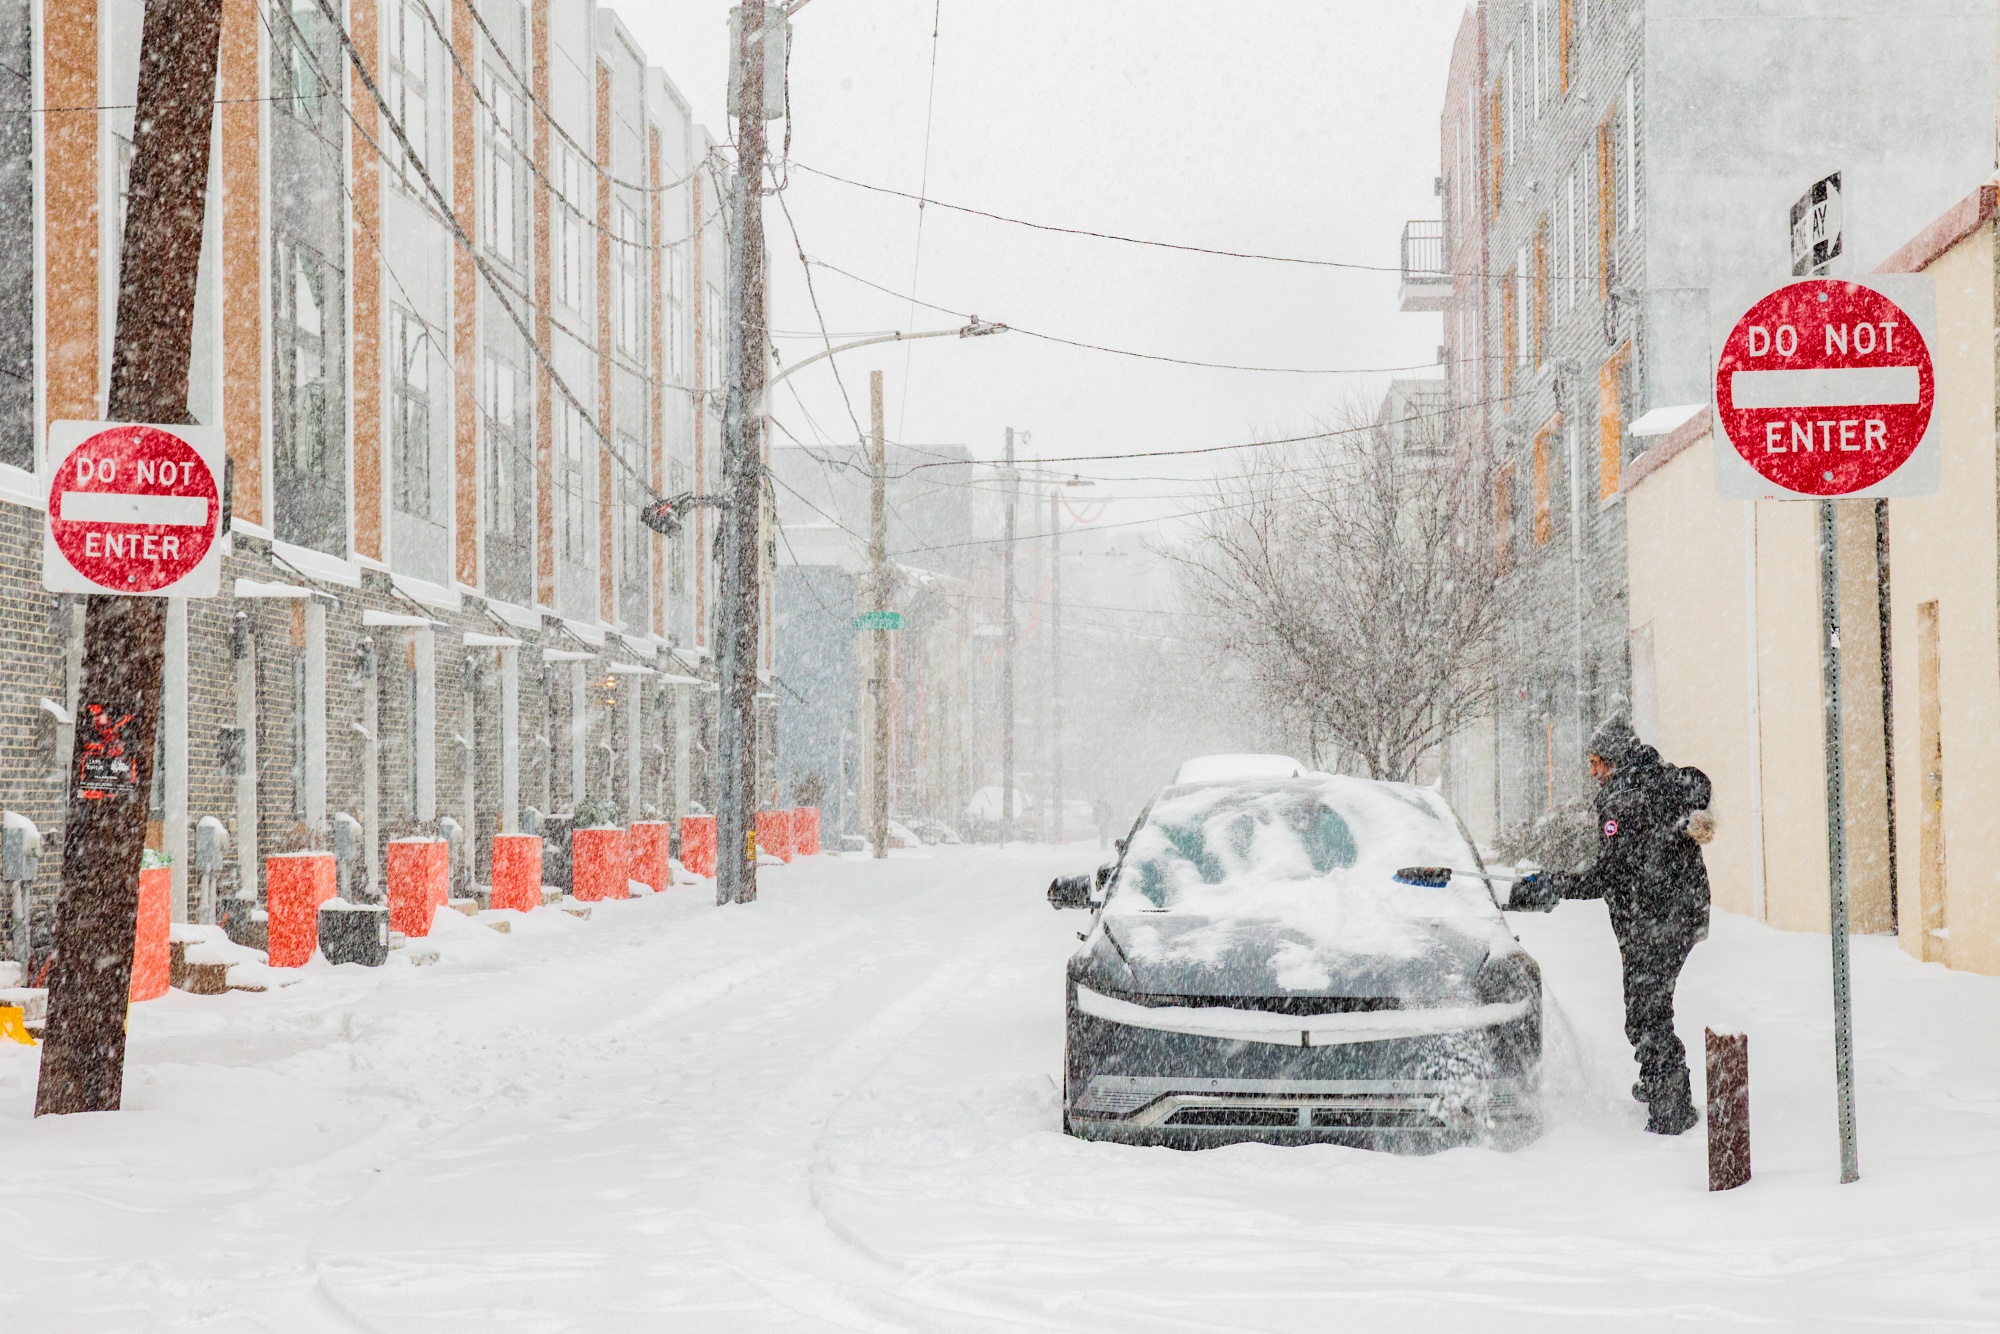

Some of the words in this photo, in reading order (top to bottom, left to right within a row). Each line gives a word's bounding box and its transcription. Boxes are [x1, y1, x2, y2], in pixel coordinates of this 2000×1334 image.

[1794, 220, 1808, 257] ONE
[1812, 203, 1828, 241] AY
[1749, 323, 1798, 357] DO
[1825, 321, 1899, 355] NOT
[1766, 419, 1888, 454] ENTER
[76, 457, 116, 483] DO
[137, 460, 195, 487] NOT
[85, 532, 181, 560] ENTER
